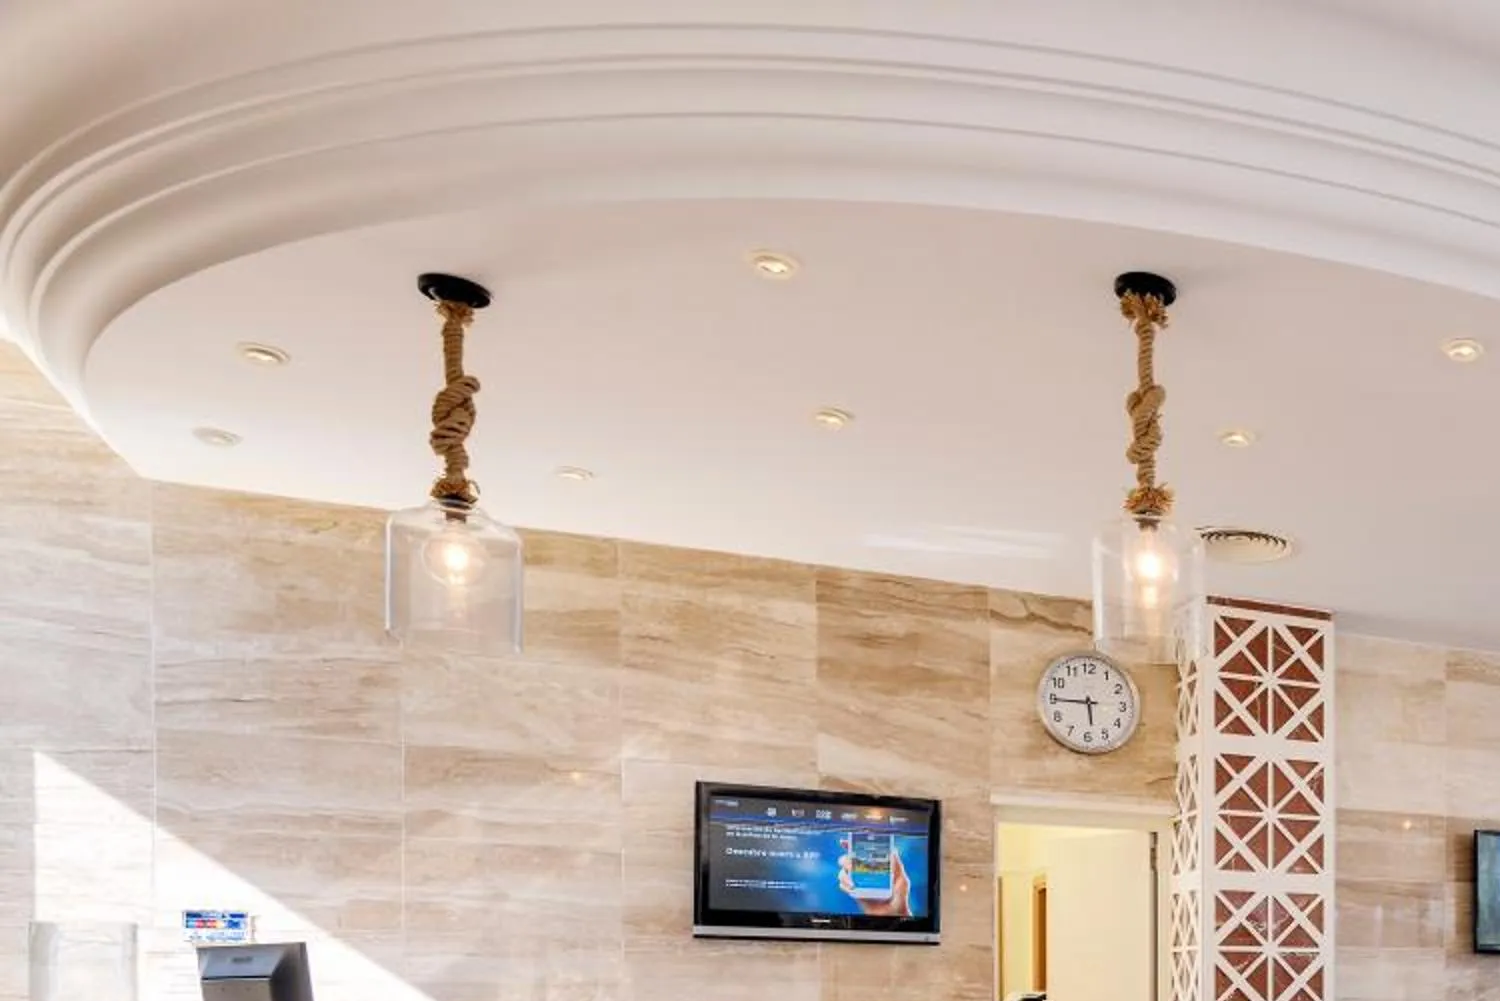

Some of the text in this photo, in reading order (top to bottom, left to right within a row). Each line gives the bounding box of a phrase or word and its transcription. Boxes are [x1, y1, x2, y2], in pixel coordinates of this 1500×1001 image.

[1066, 665, 1077, 677] 11
[1082, 663, 1096, 674] 12
[1104, 670, 1109, 681] 1
[1052, 677, 1065, 689] 10
[1114, 683, 1123, 694] 2
[1119, 701, 1127, 712] 3
[1053, 710, 1062, 722] 8
[1113, 718, 1121, 728] 4
[1066, 725, 1075, 736] 7
[1101, 728, 1109, 740] 5
[1083, 731, 1093, 742] 6
